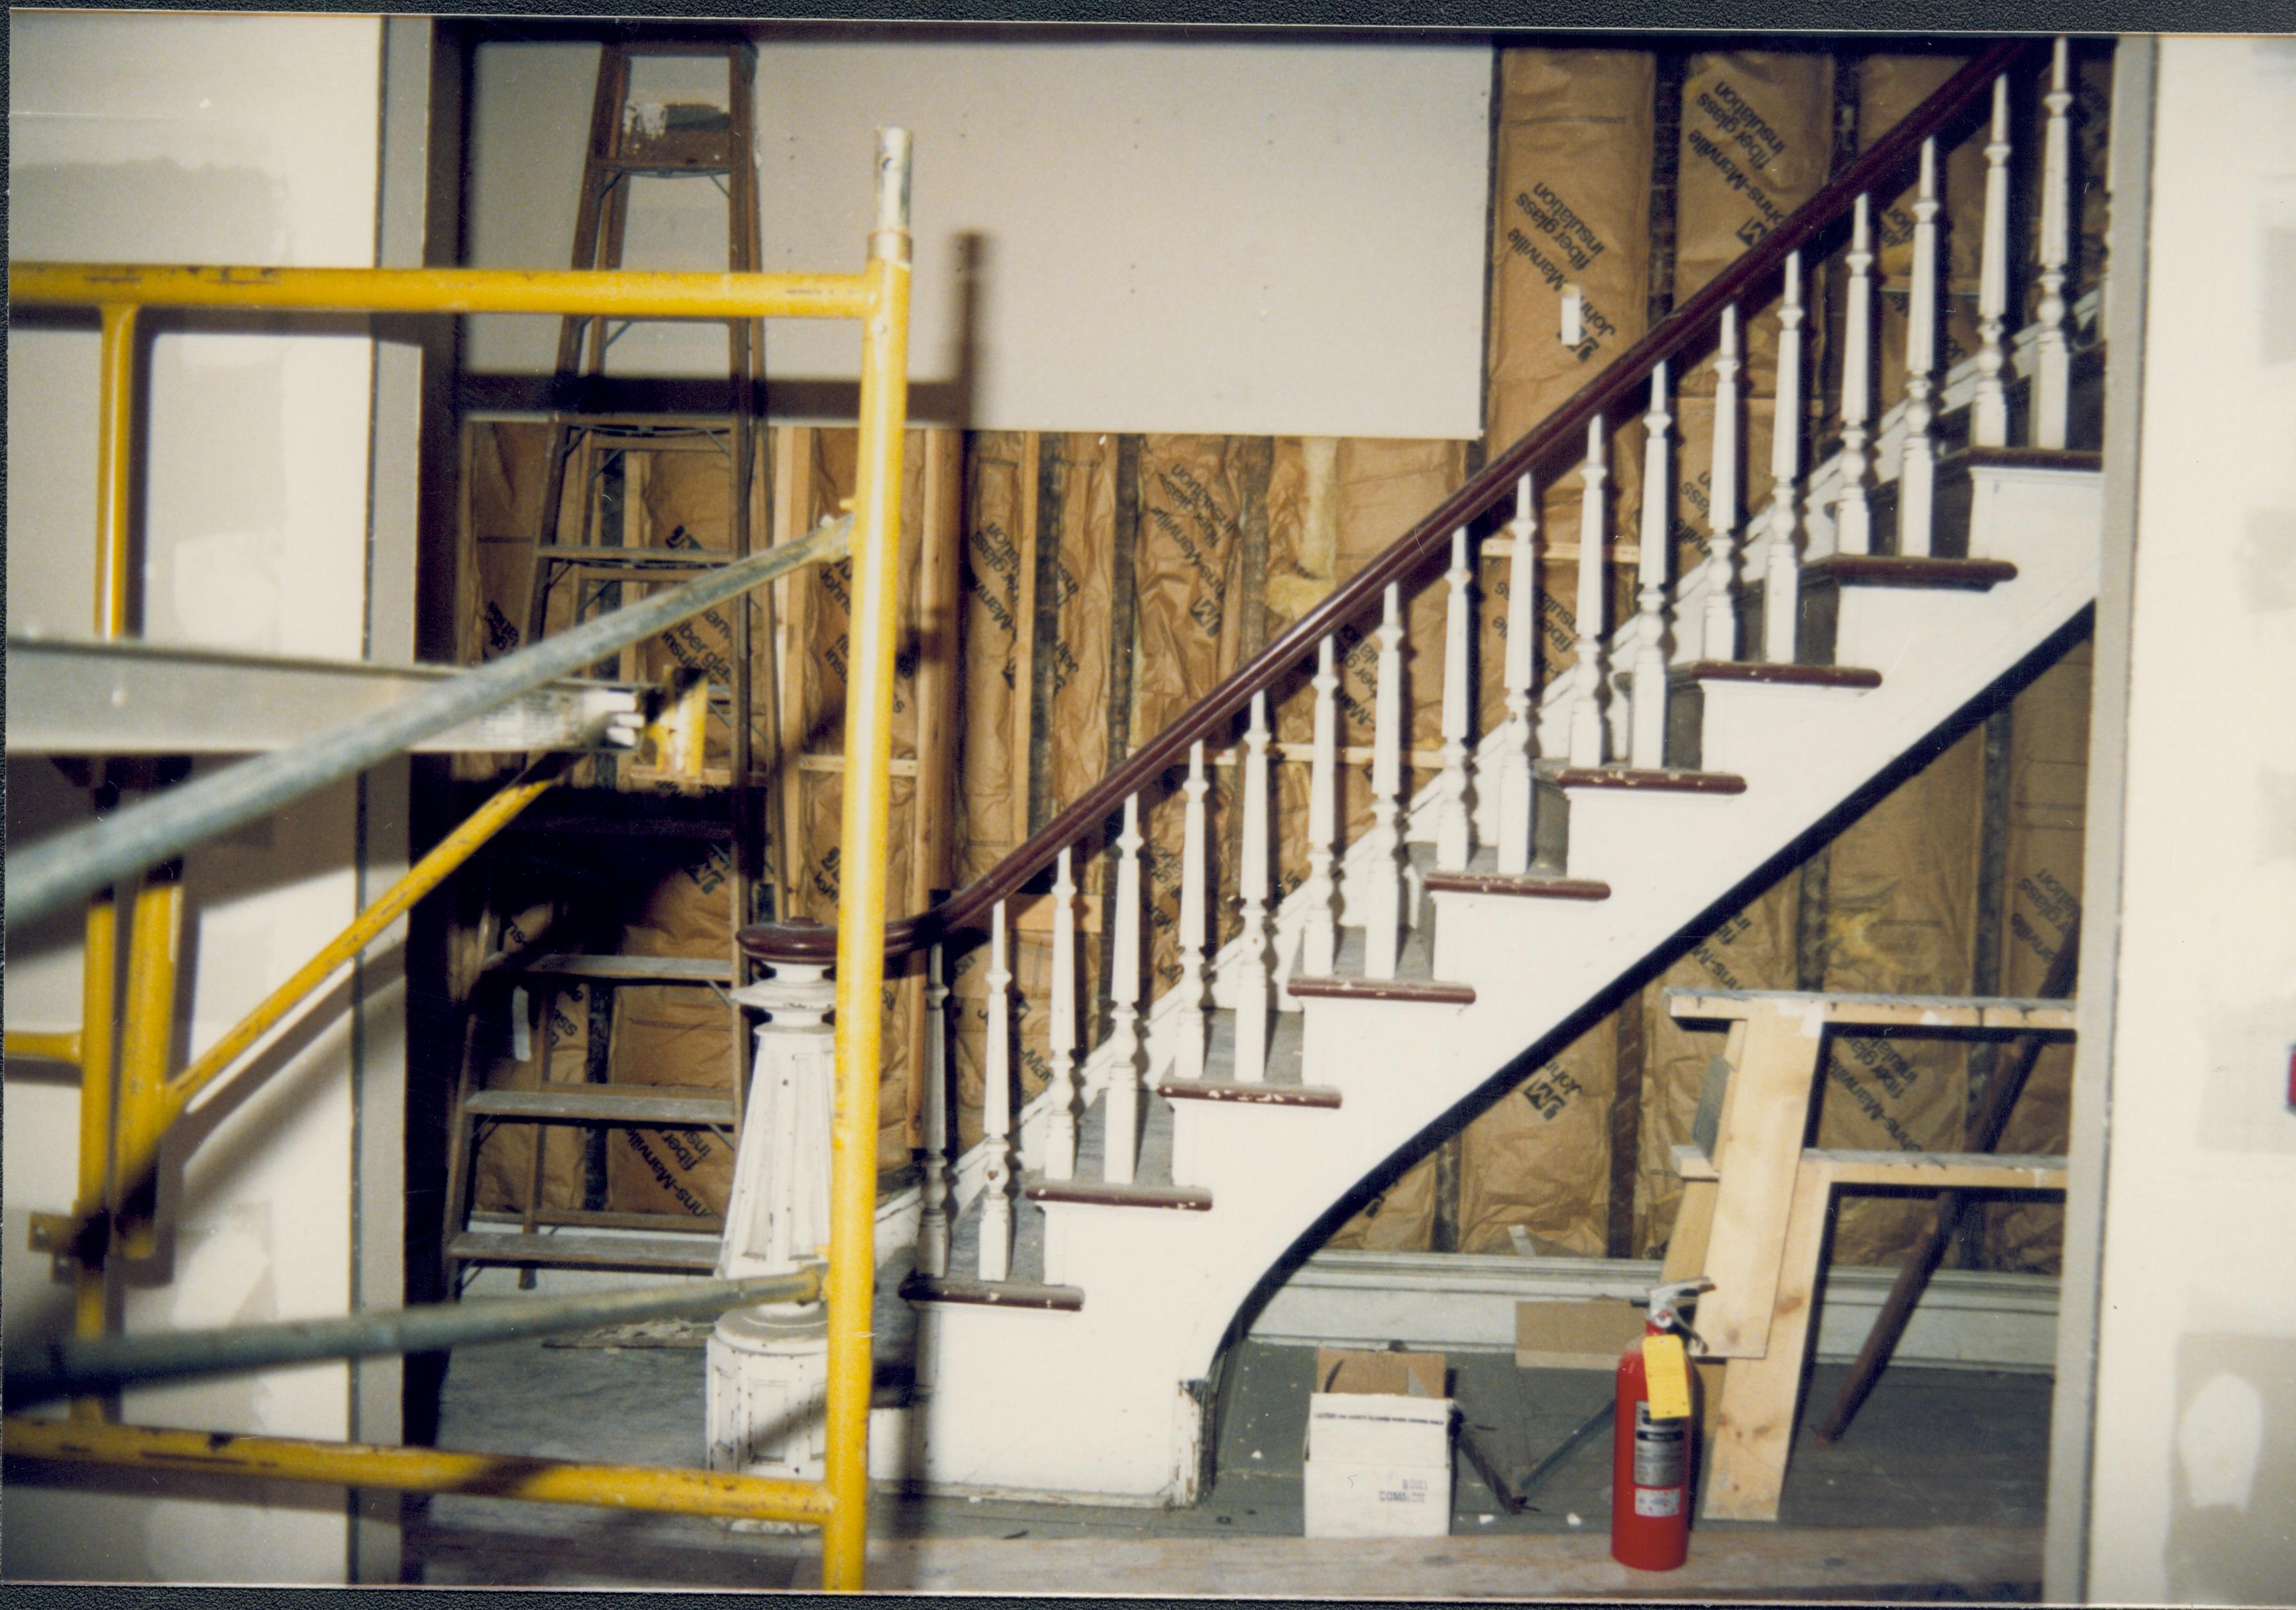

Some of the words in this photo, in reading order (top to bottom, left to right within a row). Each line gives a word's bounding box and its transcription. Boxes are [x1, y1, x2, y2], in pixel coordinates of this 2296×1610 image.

[1695, 92, 1739, 135] glass
[1712, 82, 1785, 155] insulation
[1733, 132, 1770, 169] fiber
[1687, 129, 1783, 226] ohns-Manville
[1513, 191, 1557, 236] glass
[1532, 183, 1605, 256] insulation
[1551, 232, 1590, 270] fiber
[1680, 481, 1710, 519] lass
